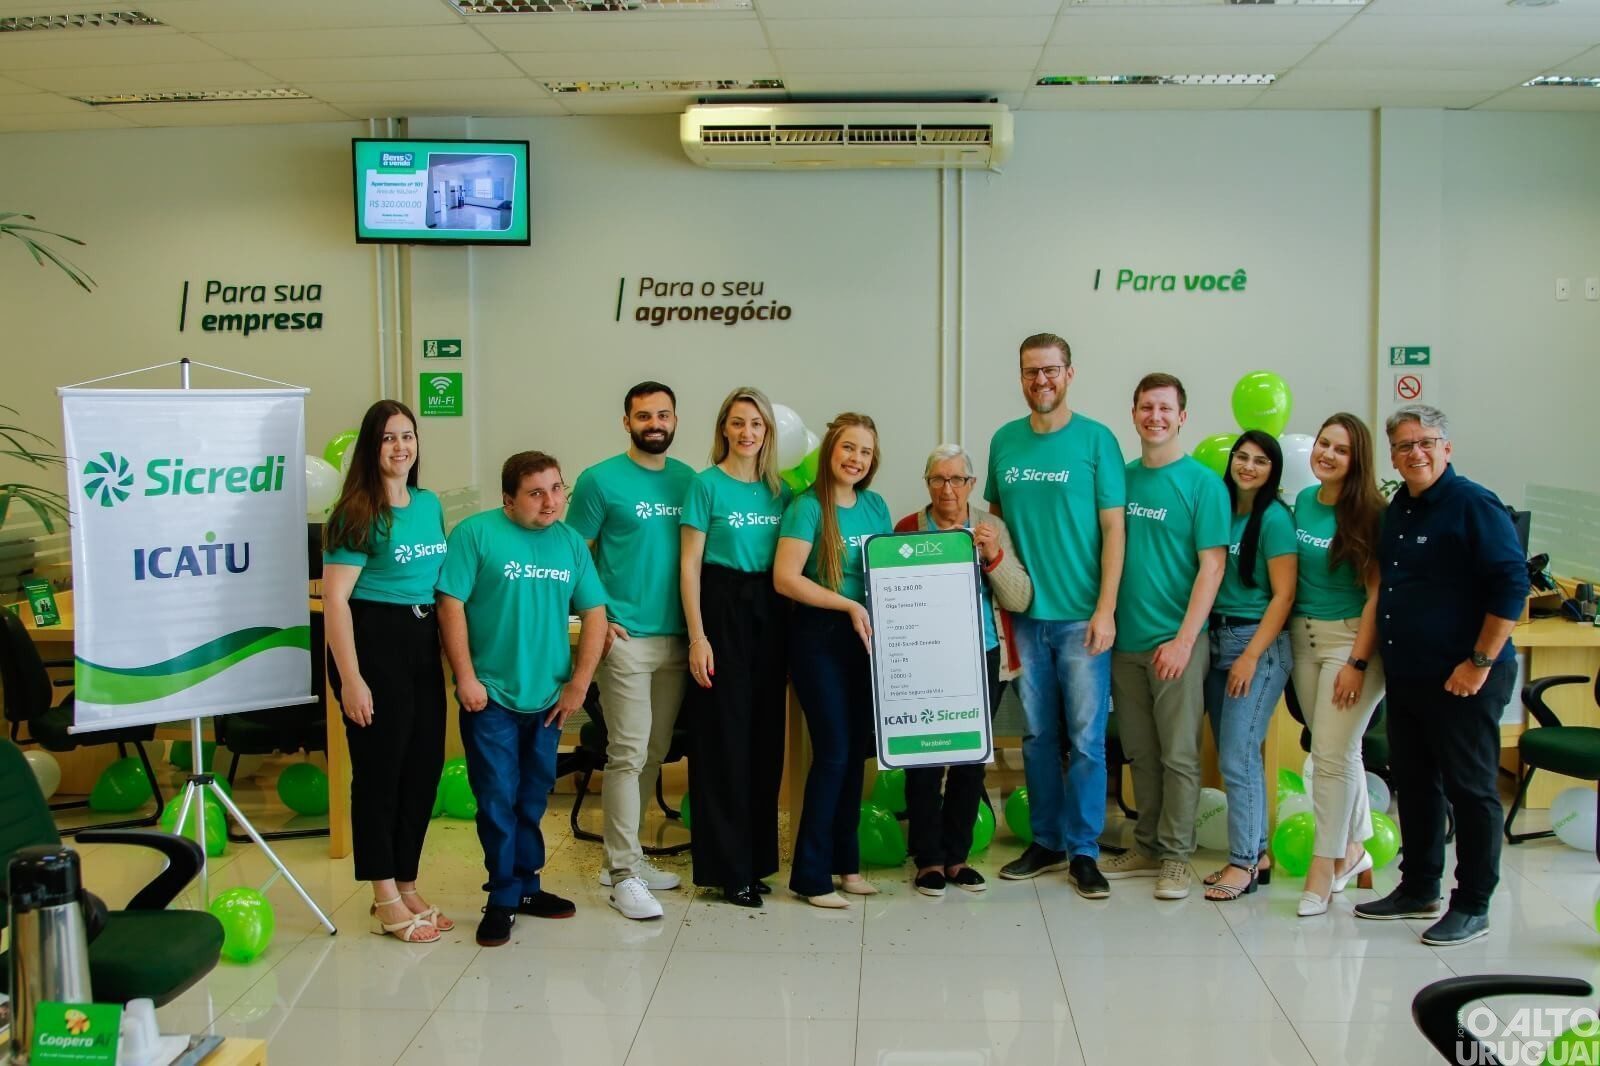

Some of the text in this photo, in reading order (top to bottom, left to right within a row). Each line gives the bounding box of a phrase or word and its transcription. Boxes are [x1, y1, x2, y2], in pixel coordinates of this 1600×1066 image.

[383, 153, 405, 161] Bens
[369, 200, 380, 208] R$
[639, 277, 764, 297] Para o seu
[1116, 268, 1247, 291] Para você
[205, 280, 322, 304] Para sua
[635, 300, 792, 326] agronegócio
[201, 311, 323, 336] empresa
[428, 396, 455, 405] Wi-Fi
[144, 455, 285, 497] Sicredi
[1021, 468, 1070, 483] Sicredi
[1126, 502, 1168, 521] Sicredi
[915, 540, 943, 556] pix
[1295, 528, 1334, 549] Sicred
[133, 531, 250, 580] ICATU
[413, 540, 448, 559] Sicred
[523, 564, 571, 584] Sicredi
[884, 708, 980, 726] ICATU Sicredi
[39, 1032, 94, 1048] Coopera
